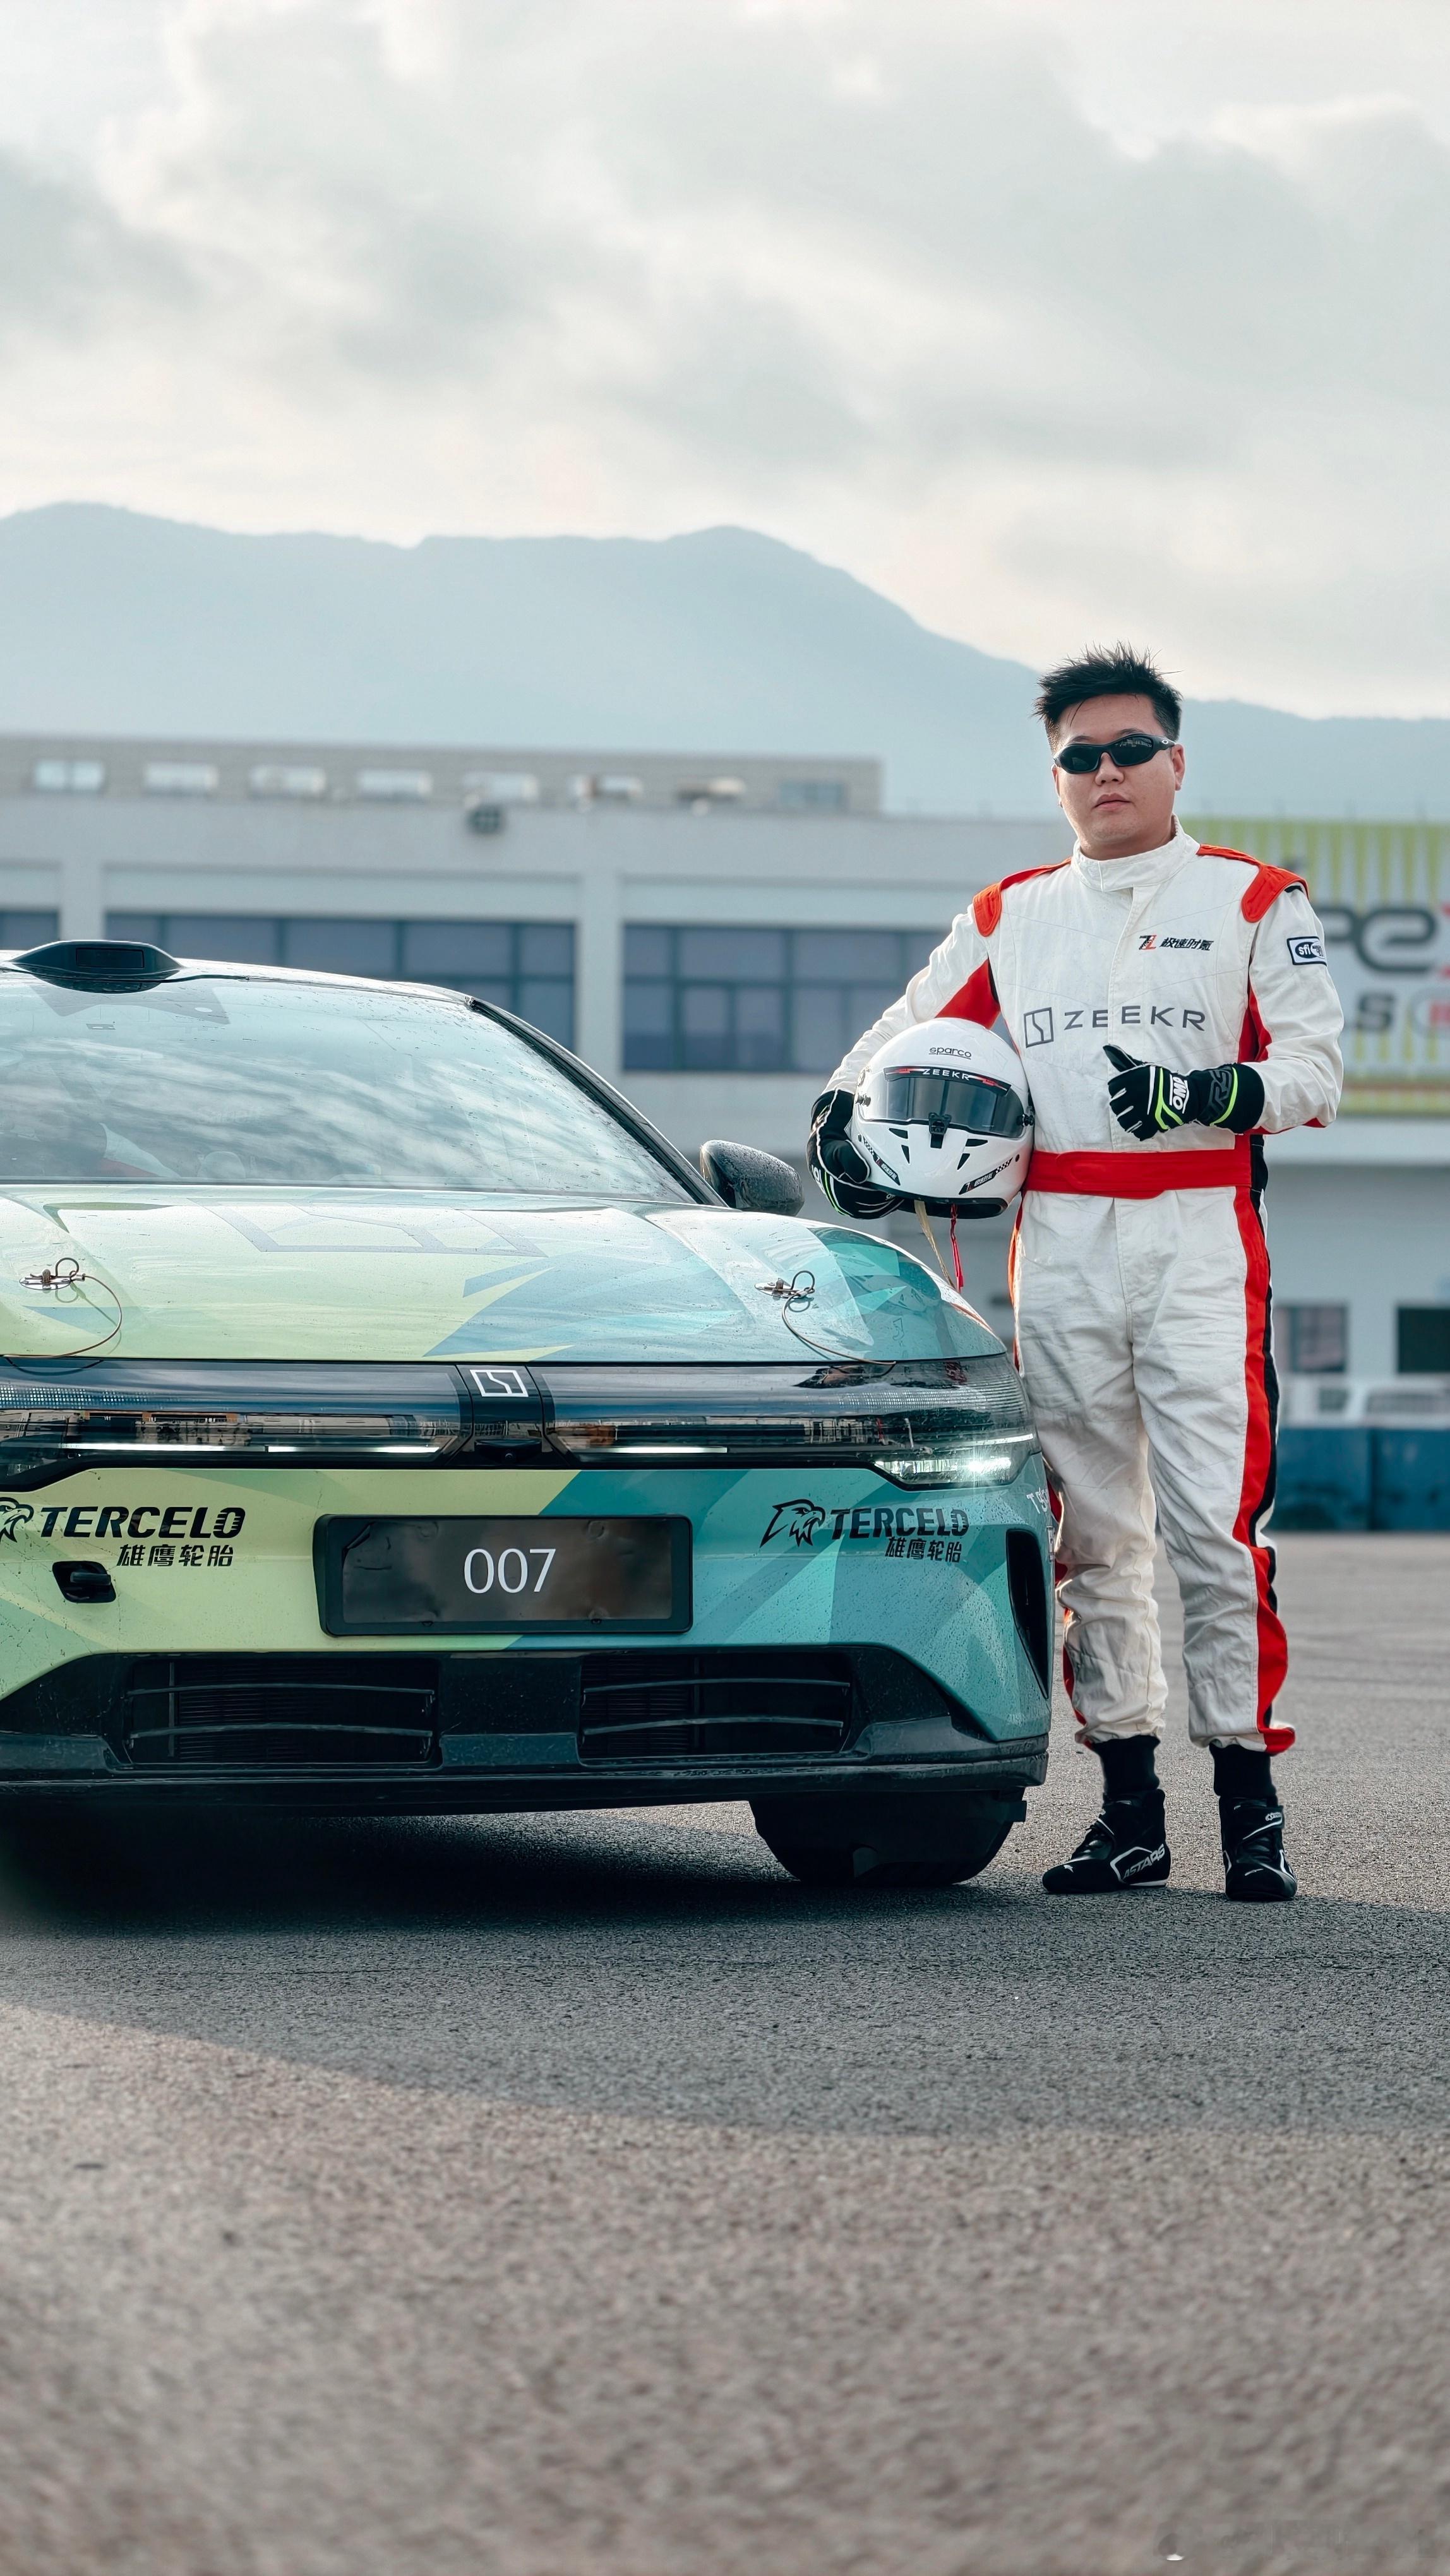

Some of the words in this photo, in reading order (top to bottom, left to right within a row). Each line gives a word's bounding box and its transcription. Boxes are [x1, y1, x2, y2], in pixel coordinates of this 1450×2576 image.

[1064, 1005, 1205, 1031] ZEEKR
[929, 1047, 972, 1058] sparco
[922, 1068, 970, 1080] ZEEKR
[1172, 1076, 1187, 1110] OMP
[40, 1506, 246, 1538] TERCELO
[116, 1544, 234, 1567] 雄鹰轮胎
[885, 1536, 962, 1563] 雄鹰轮胎
[464, 1548, 556, 1594] 007
